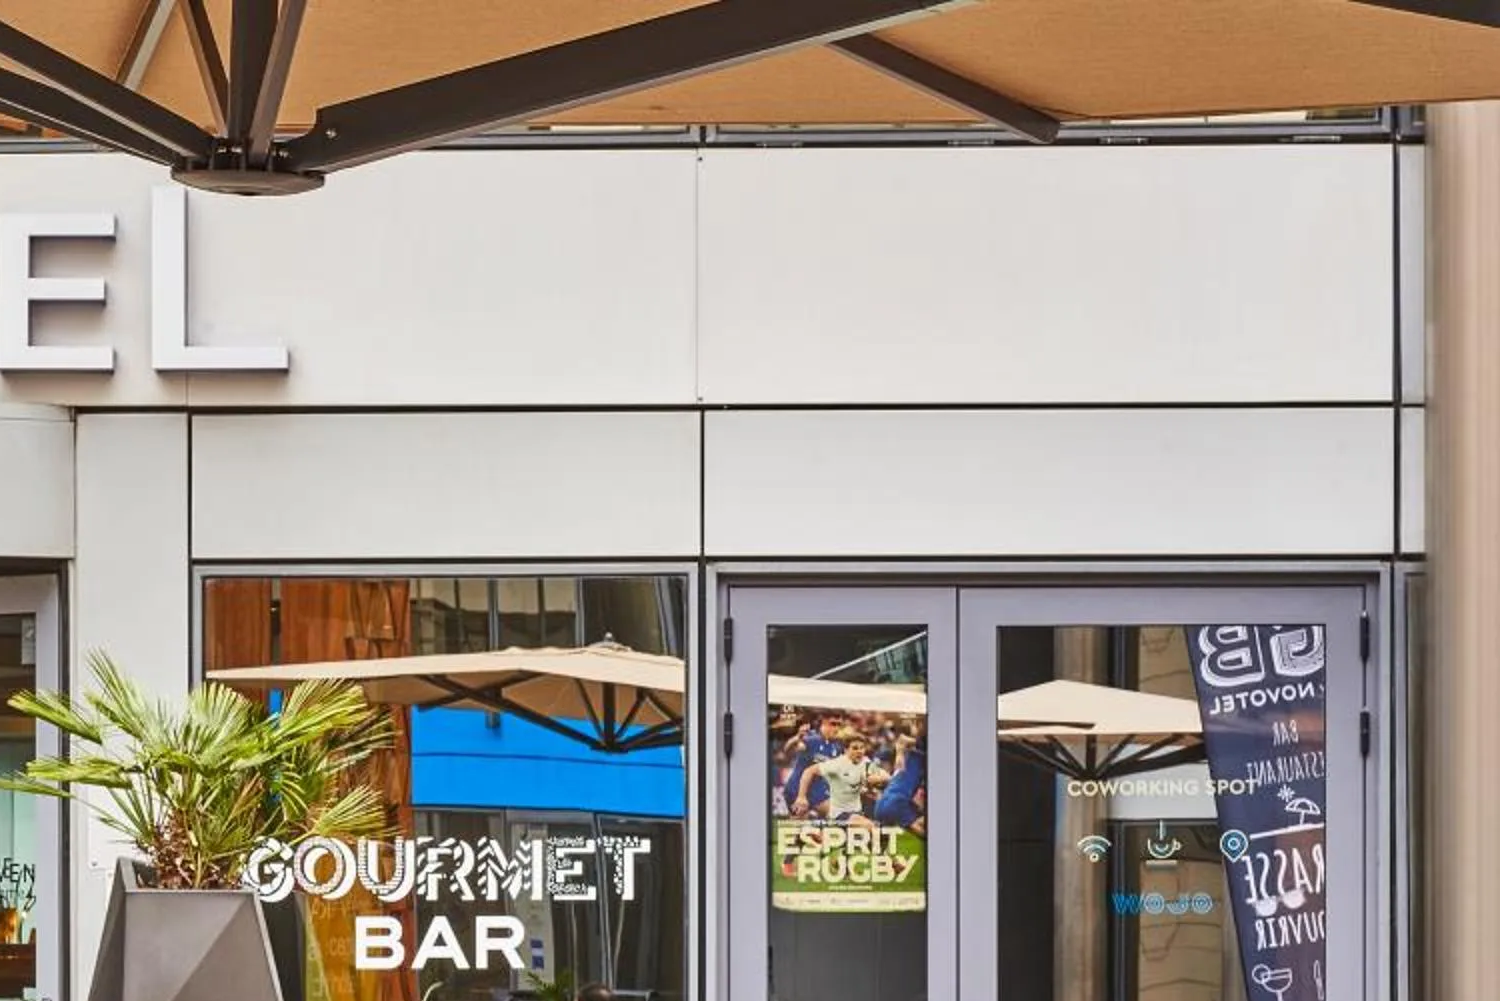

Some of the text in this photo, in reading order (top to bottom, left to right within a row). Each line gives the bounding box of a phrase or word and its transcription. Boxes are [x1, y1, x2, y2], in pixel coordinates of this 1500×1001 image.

[1067, 779, 1257, 797] COWORKING SPOT
[777, 827, 904, 855] ESPRIT
[242, 836, 651, 903] GOURMET
[797, 854, 919, 883] RUGBY
[355, 915, 525, 970] BAR
